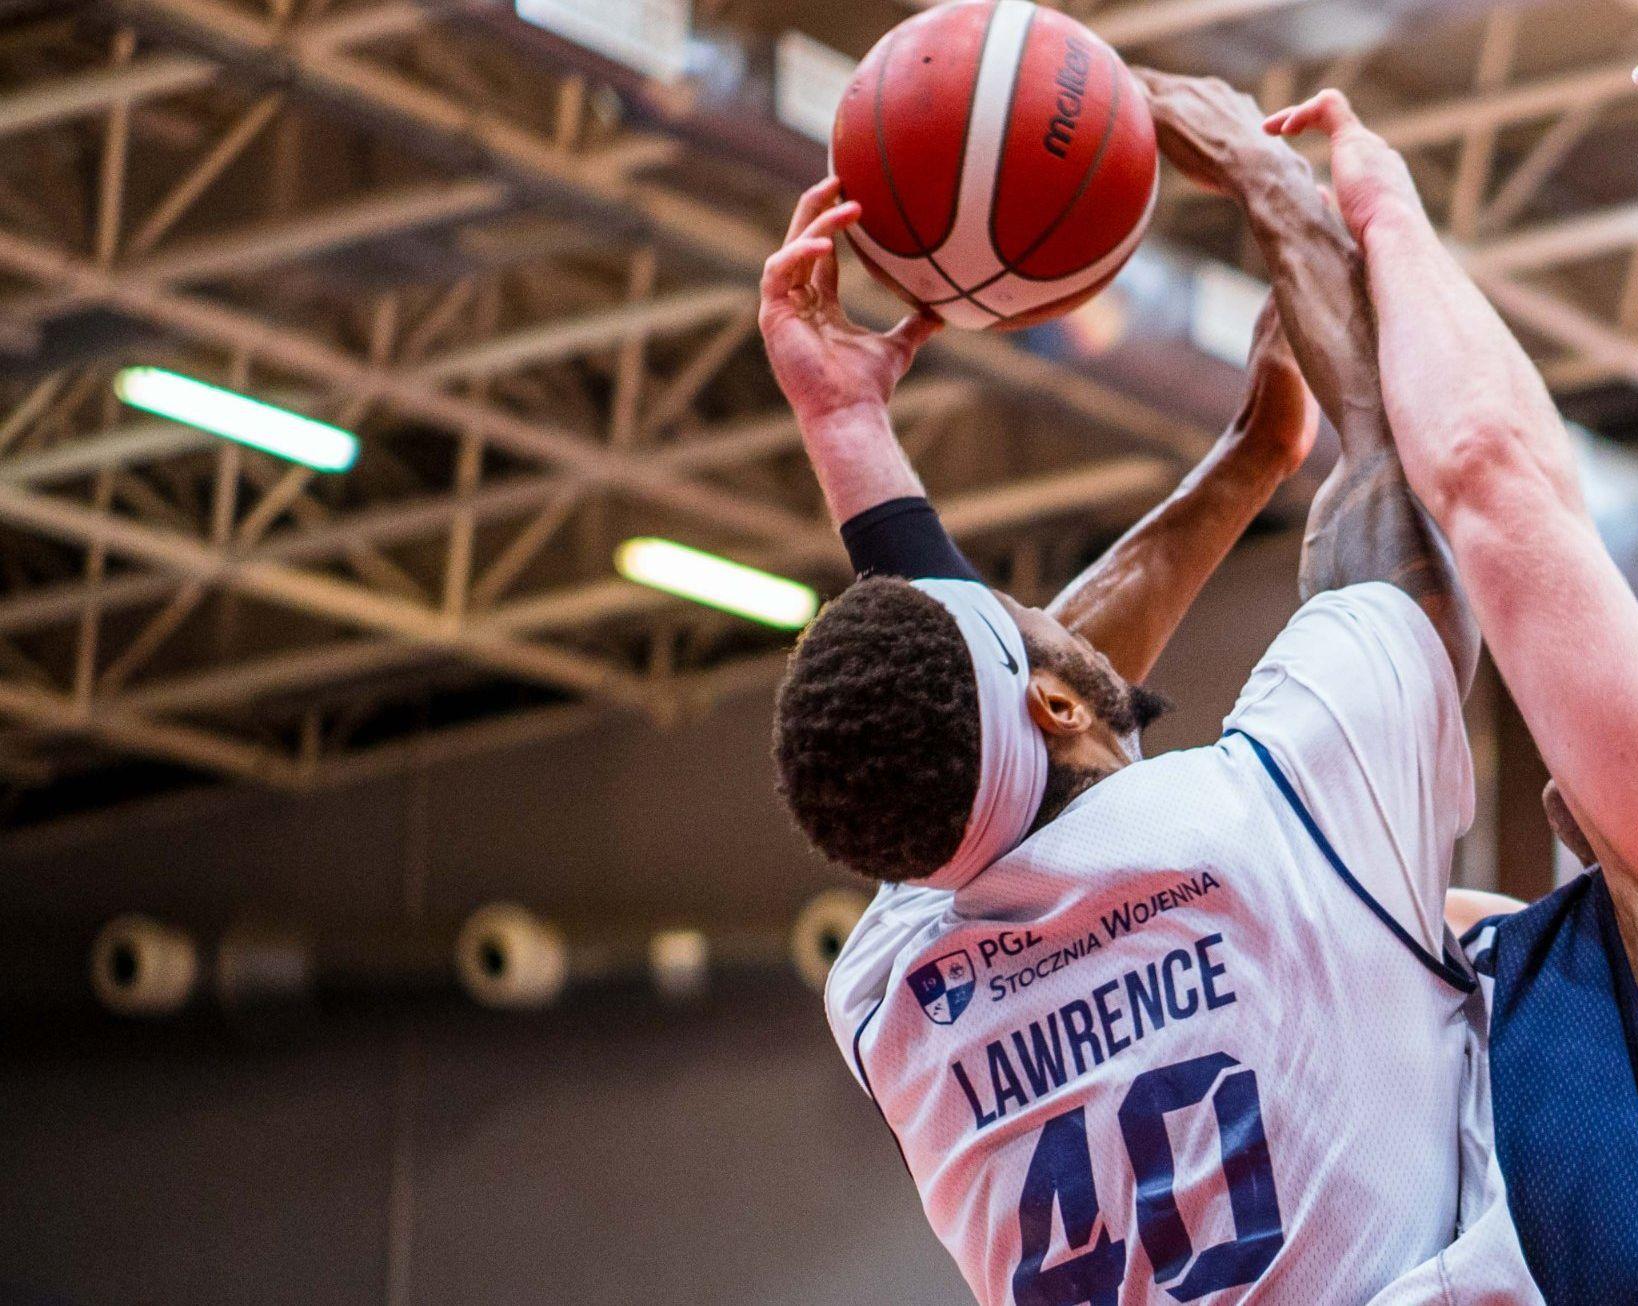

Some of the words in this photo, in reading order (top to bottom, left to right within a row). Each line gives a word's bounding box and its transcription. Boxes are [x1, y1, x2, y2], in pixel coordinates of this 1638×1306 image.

[1043, 35, 1090, 160] molten
[951, 932, 1237, 1131] LAWRENCE
[1011, 1051, 1285, 1306] 40
